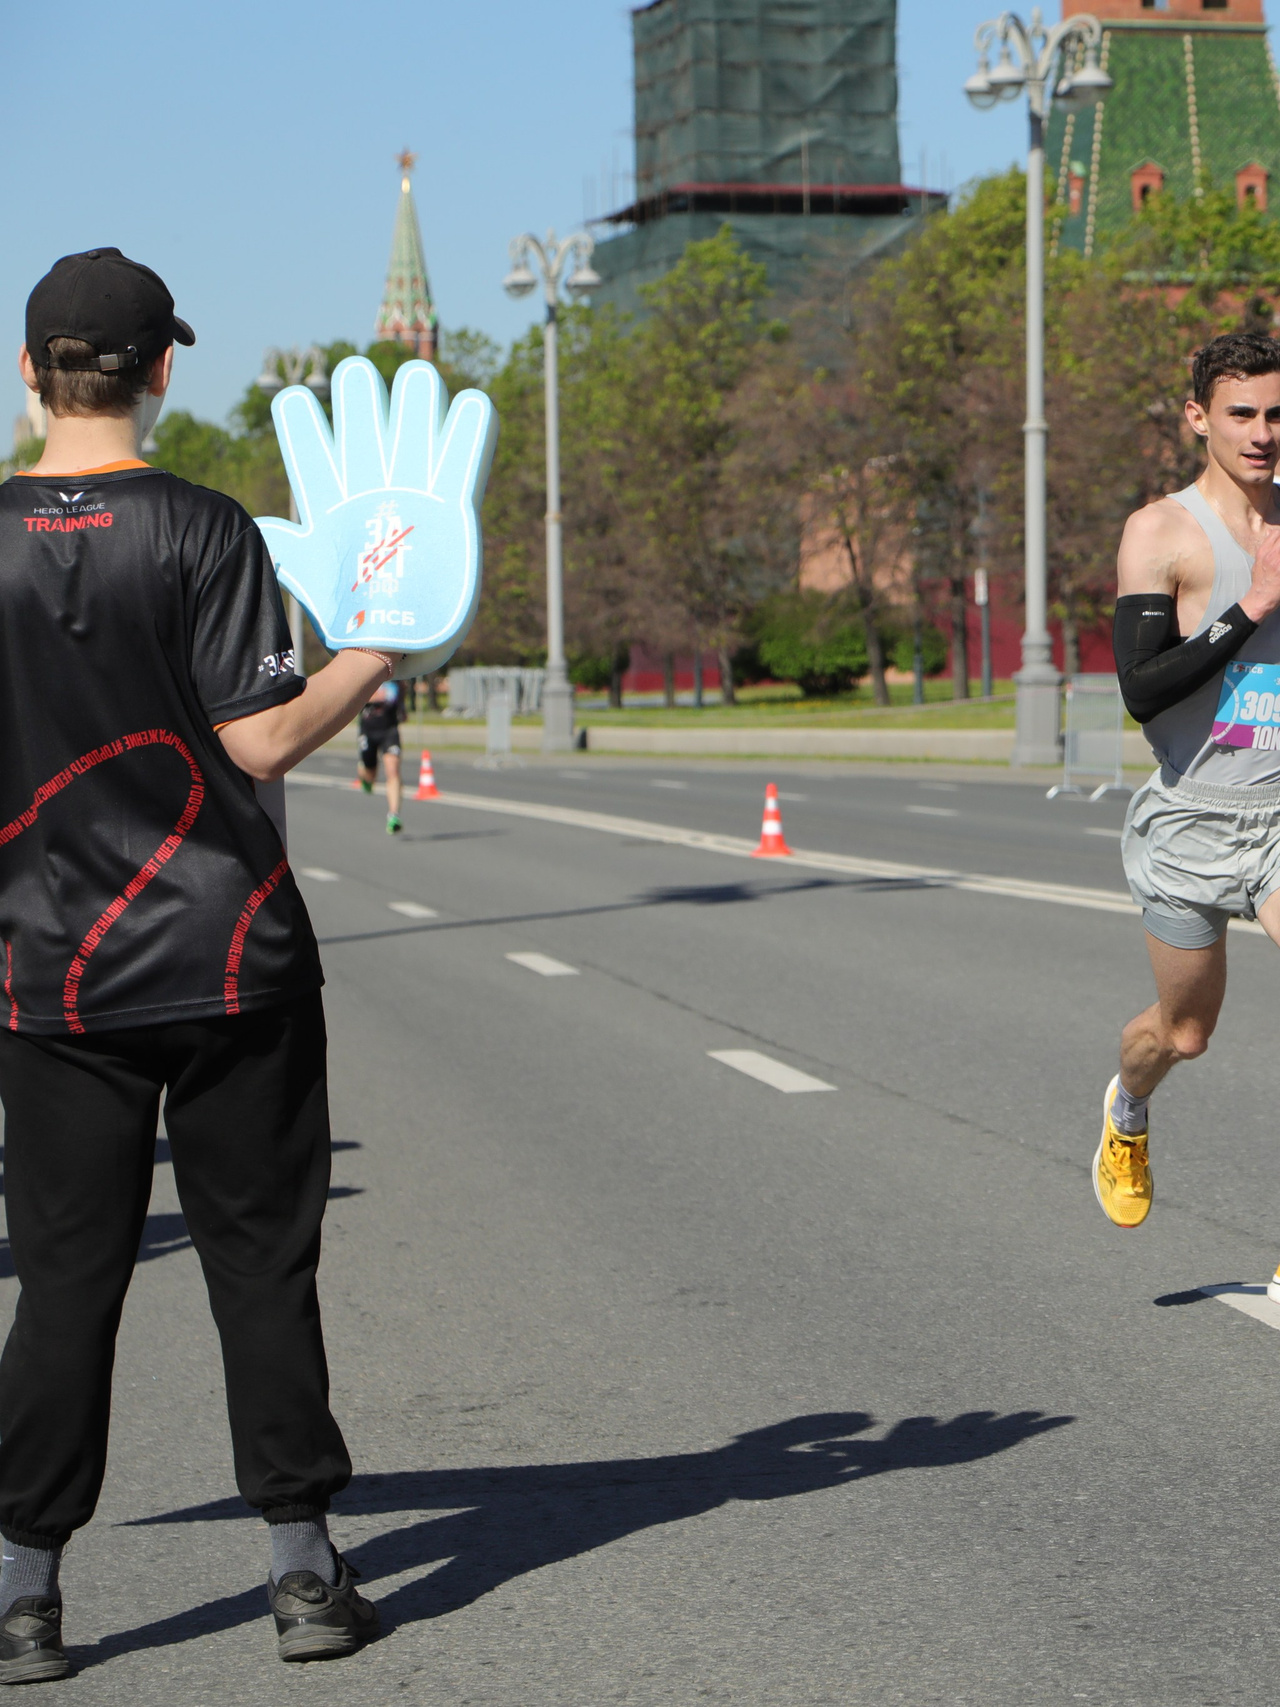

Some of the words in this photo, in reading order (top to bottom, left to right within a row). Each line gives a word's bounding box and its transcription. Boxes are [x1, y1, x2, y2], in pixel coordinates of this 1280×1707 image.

[23, 512, 114, 533] TRAINING
[33, 507, 64, 515] HERO
[66, 502, 106, 514] LEAGUE
[370, 609, 416, 626] ПСБ
[1209, 623, 1233, 644] adidas
[69, 739, 125, 775] #ГОРДОСТЬ
[174, 784, 205, 835] #СВОБОДА
[154, 834, 183, 865] #ЦЕЛЬ
[123, 858, 161, 901] #МОМЕНТ
[78, 896, 129, 958] #АДРЕНАЛИН
[225, 911, 252, 975] #УДИВЛЕНИЕ
[63, 954, 88, 1009] #ВОСТОРГ
